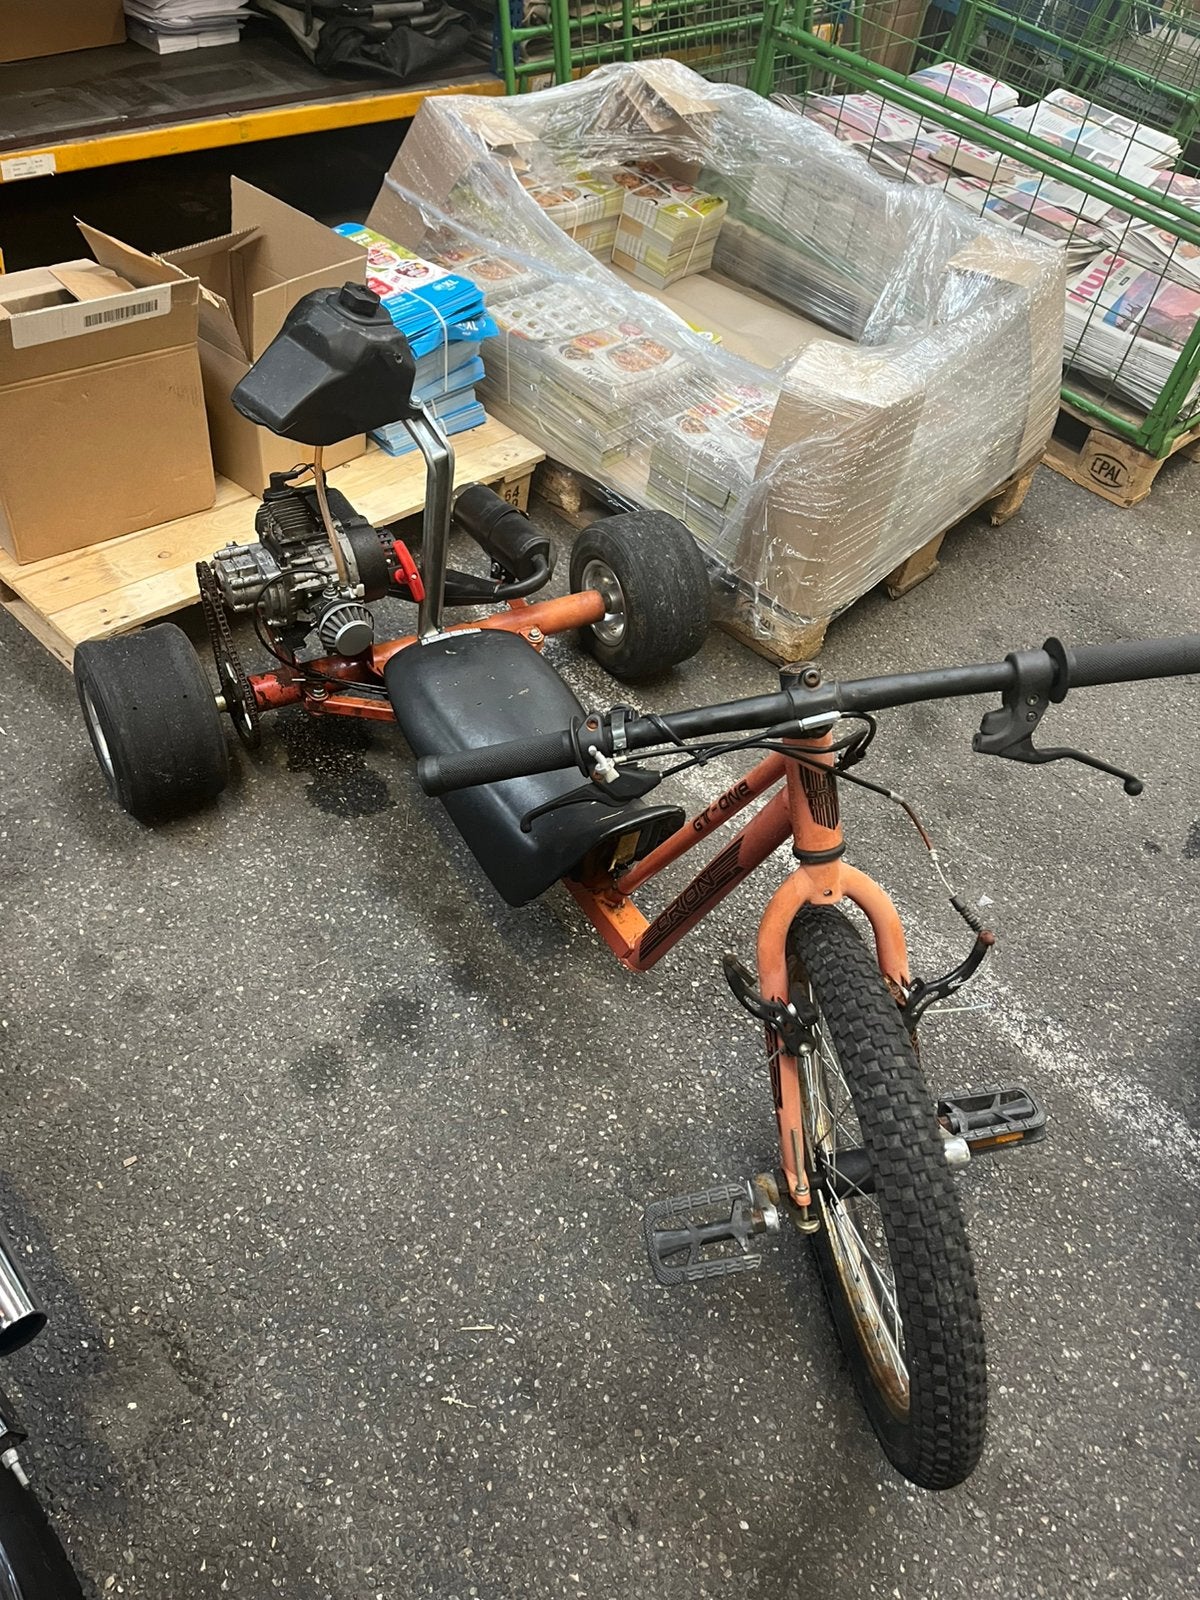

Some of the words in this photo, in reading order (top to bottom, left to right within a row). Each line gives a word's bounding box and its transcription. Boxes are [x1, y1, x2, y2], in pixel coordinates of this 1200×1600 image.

[935, 133, 990, 159] HULS
[1068, 252, 1129, 303] HULS
[1090, 457, 1122, 484] EPAL
[504, 485, 520, 502] 64
